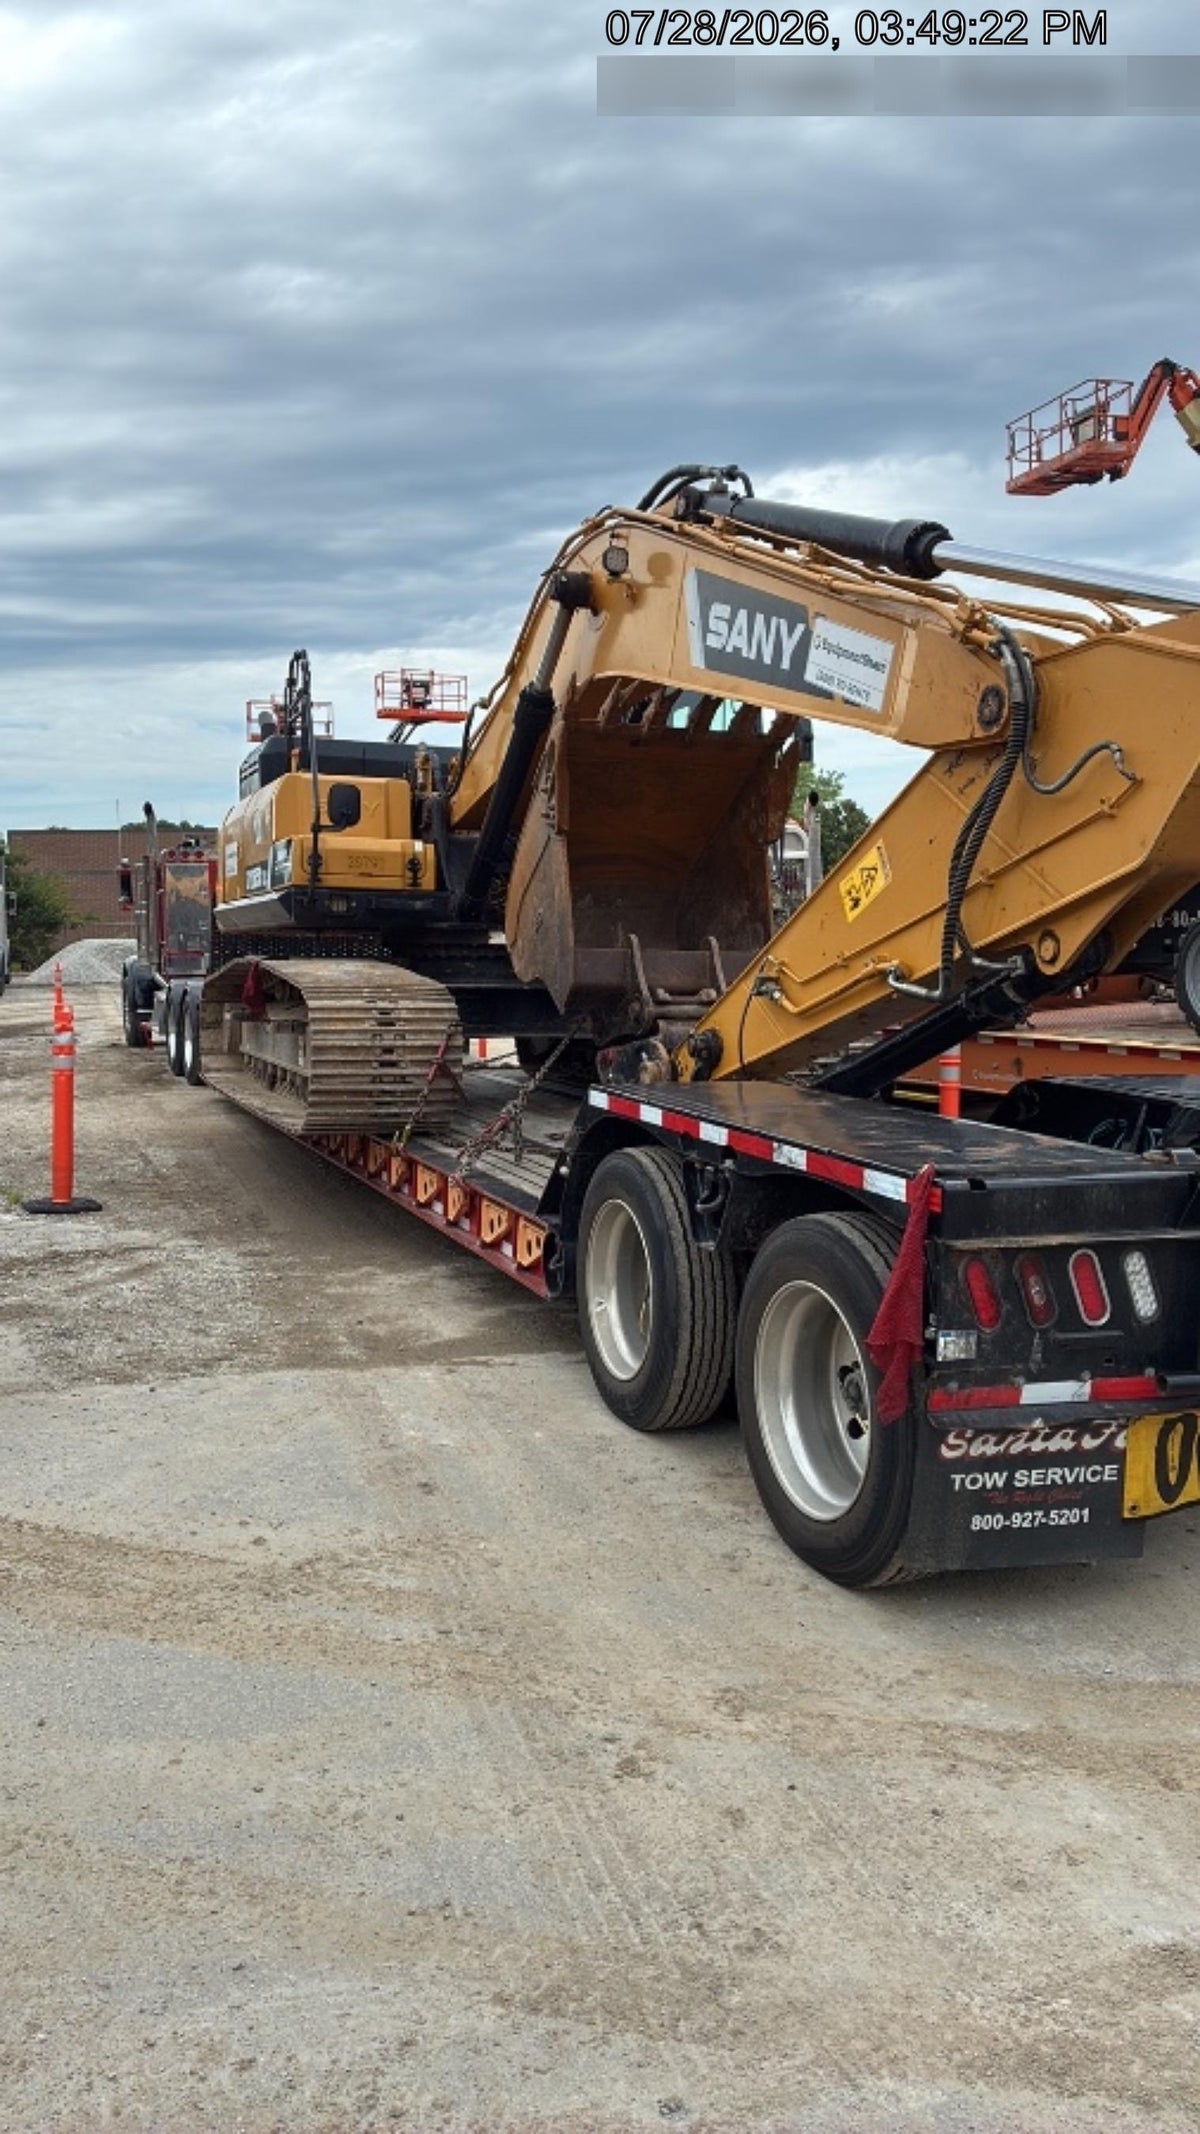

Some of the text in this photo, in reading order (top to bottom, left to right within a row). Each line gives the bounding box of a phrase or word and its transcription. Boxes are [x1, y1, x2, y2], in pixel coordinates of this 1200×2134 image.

[706, 601, 806, 670] SANY
[950, 1464, 1119, 1491] TOW SERVICE
[970, 1507, 1090, 1532] 800-927-5201
